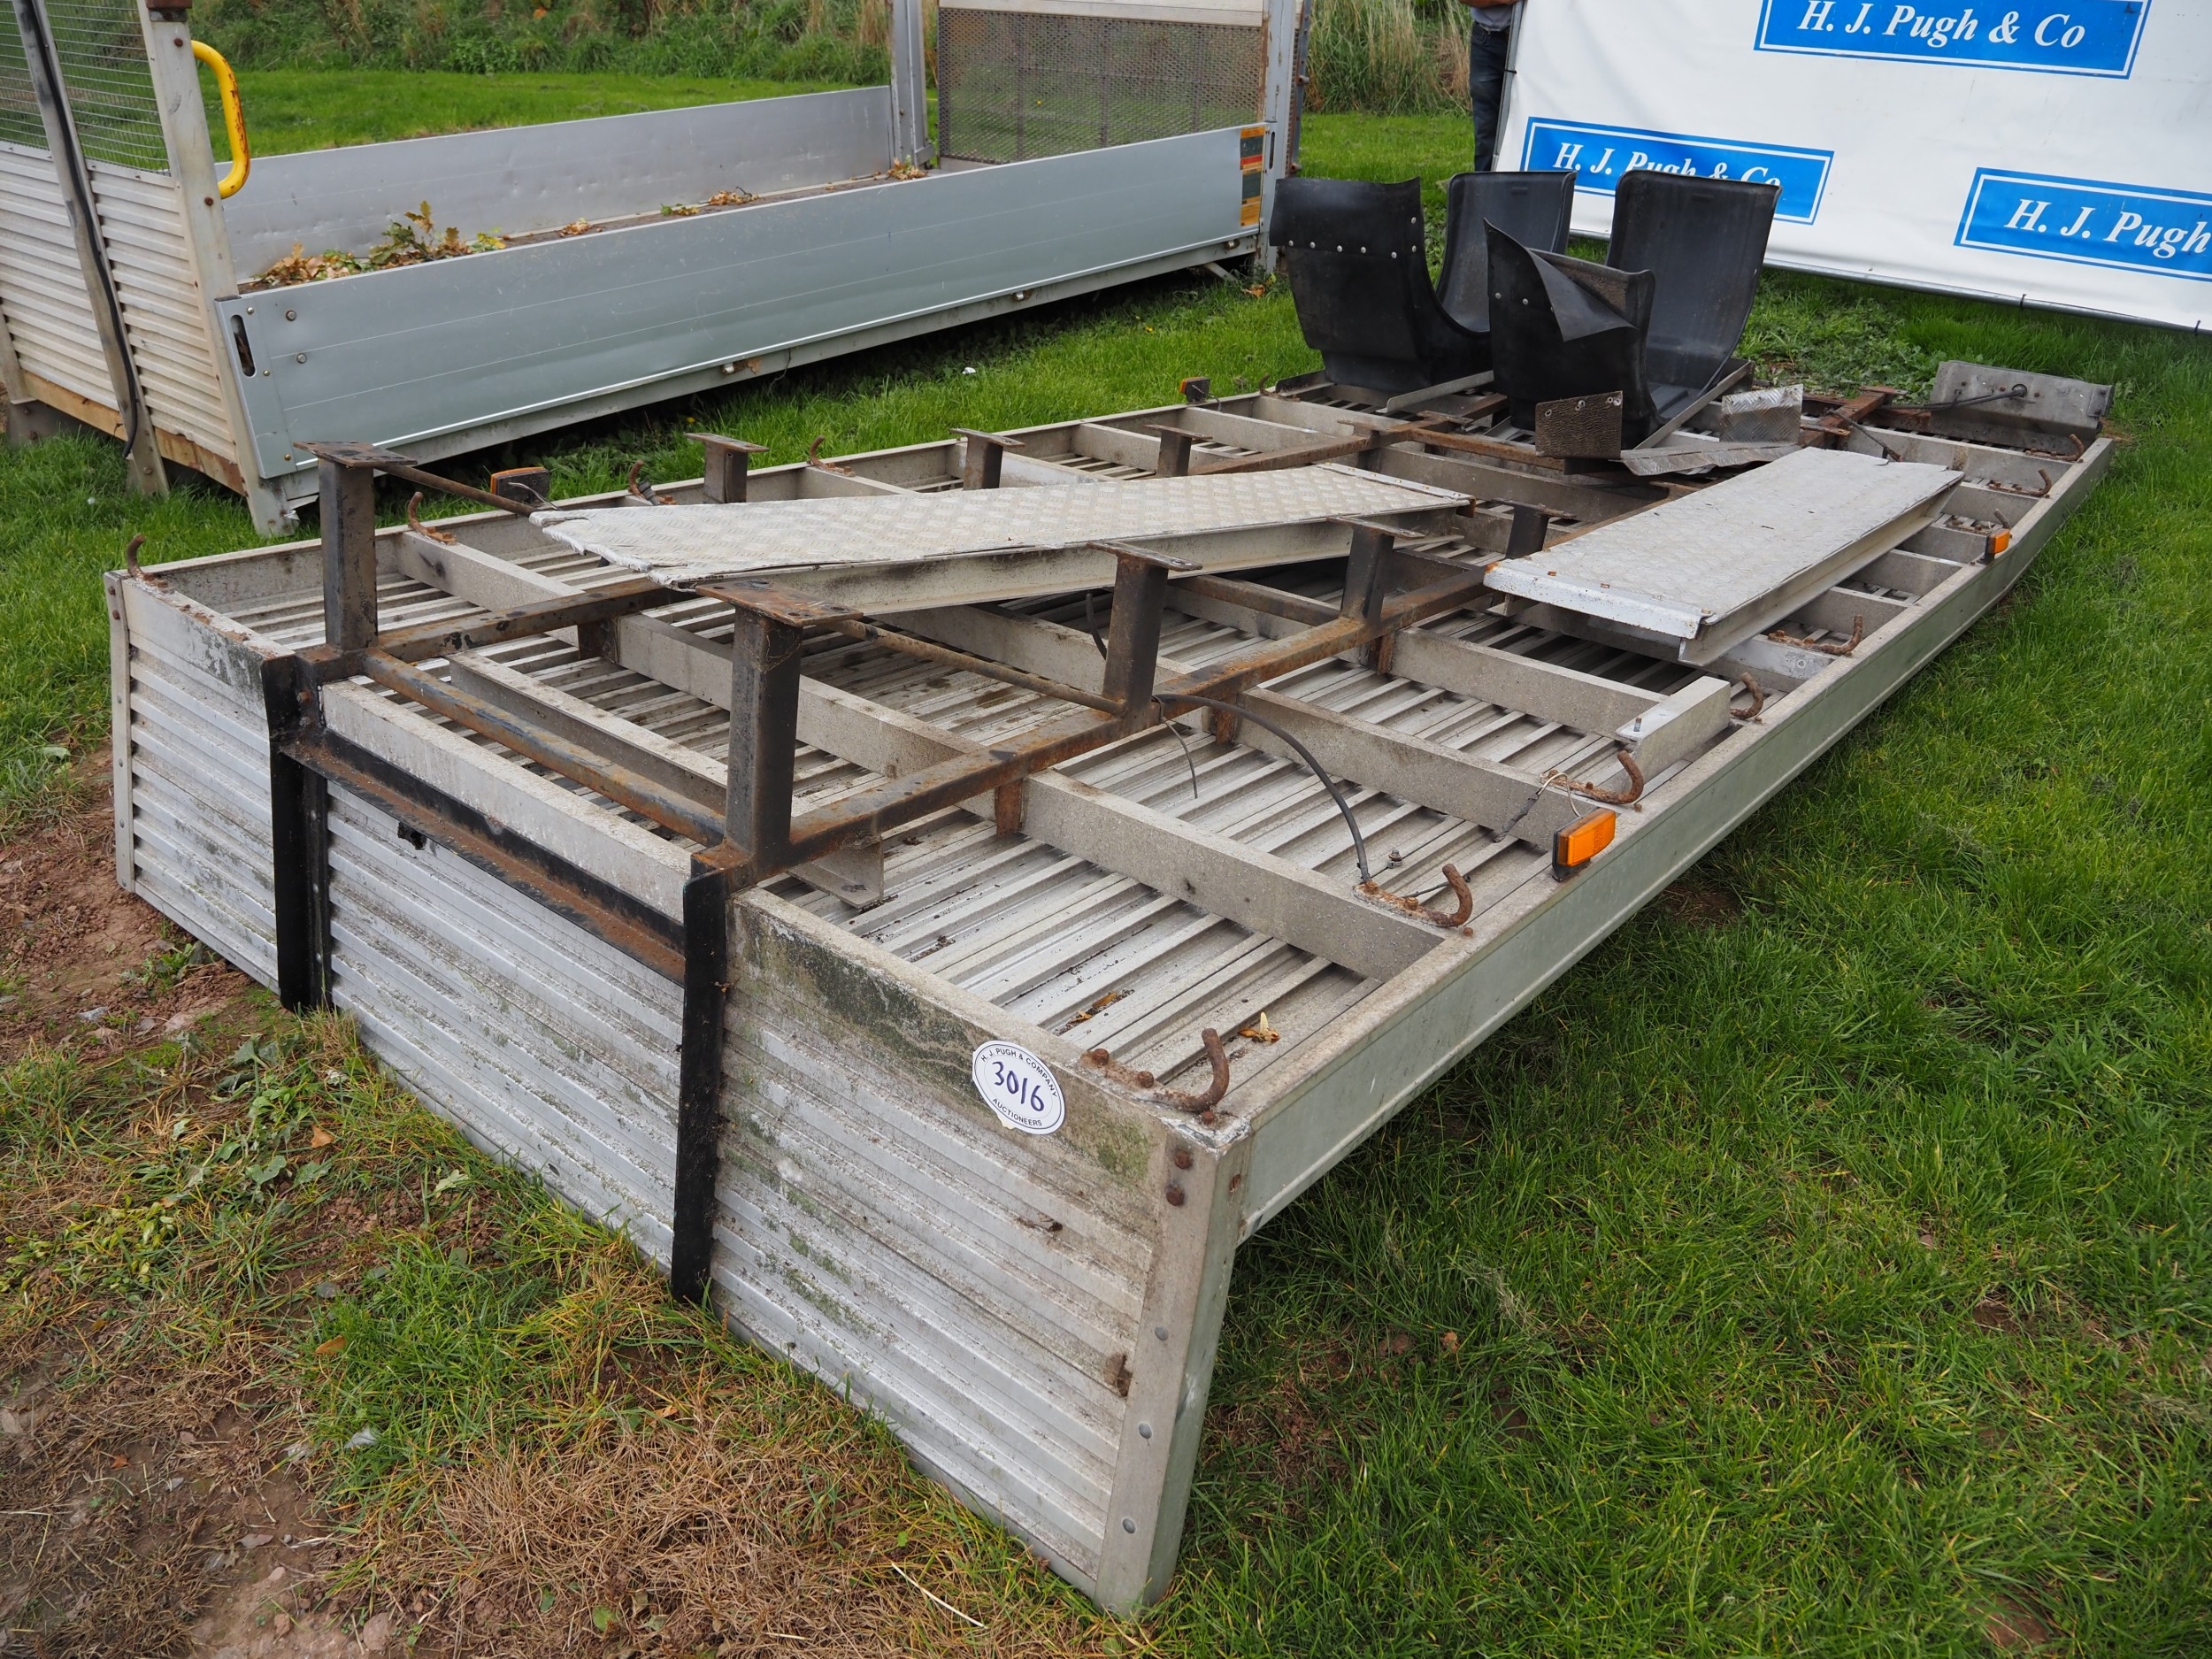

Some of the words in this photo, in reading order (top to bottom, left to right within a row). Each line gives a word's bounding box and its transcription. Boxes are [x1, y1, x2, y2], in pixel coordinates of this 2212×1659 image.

[1796, 0, 1834, 32] H.
[1845, 3, 1874, 35] J.
[1882, 4, 1978, 48] Pugh
[1988, 11, 2020, 44] &
[2034, 13, 2085, 48] Co
[1553, 142, 1585, 171] H.
[1590, 148, 1616, 175] J.
[2003, 198, 2047, 233] H.
[2060, 206, 2096, 239] J.
[2102, 211, 2212, 258] Pugh
[992, 1061, 1045, 1112] 3016
[995, 1048, 1017, 1057] PUGH
[1025, 1057, 1057, 1097] COMPANY
[992, 1098, 1042, 1126] AUCTIONEERS
